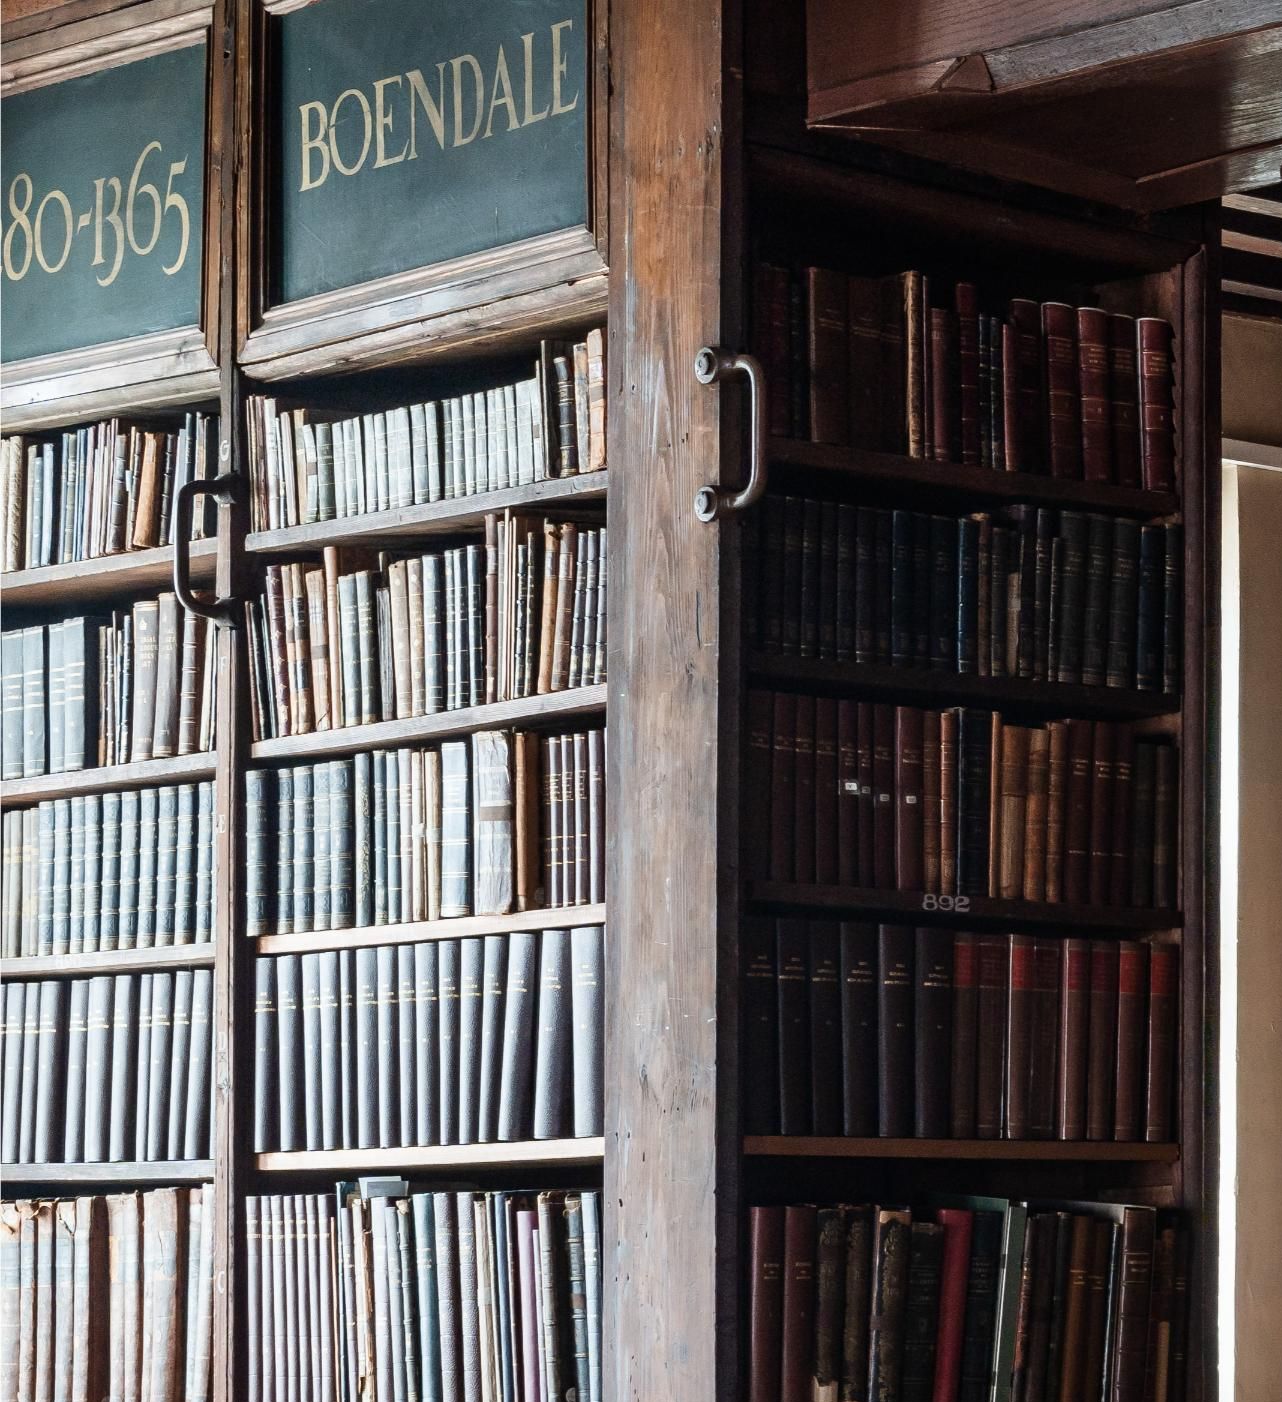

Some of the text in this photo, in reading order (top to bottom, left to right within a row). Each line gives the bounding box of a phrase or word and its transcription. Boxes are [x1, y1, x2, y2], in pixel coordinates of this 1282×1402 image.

[300, 20, 578, 192] BOENDALE
[0, 141, 189, 287] 80-1365
[922, 894, 970, 913] 892
